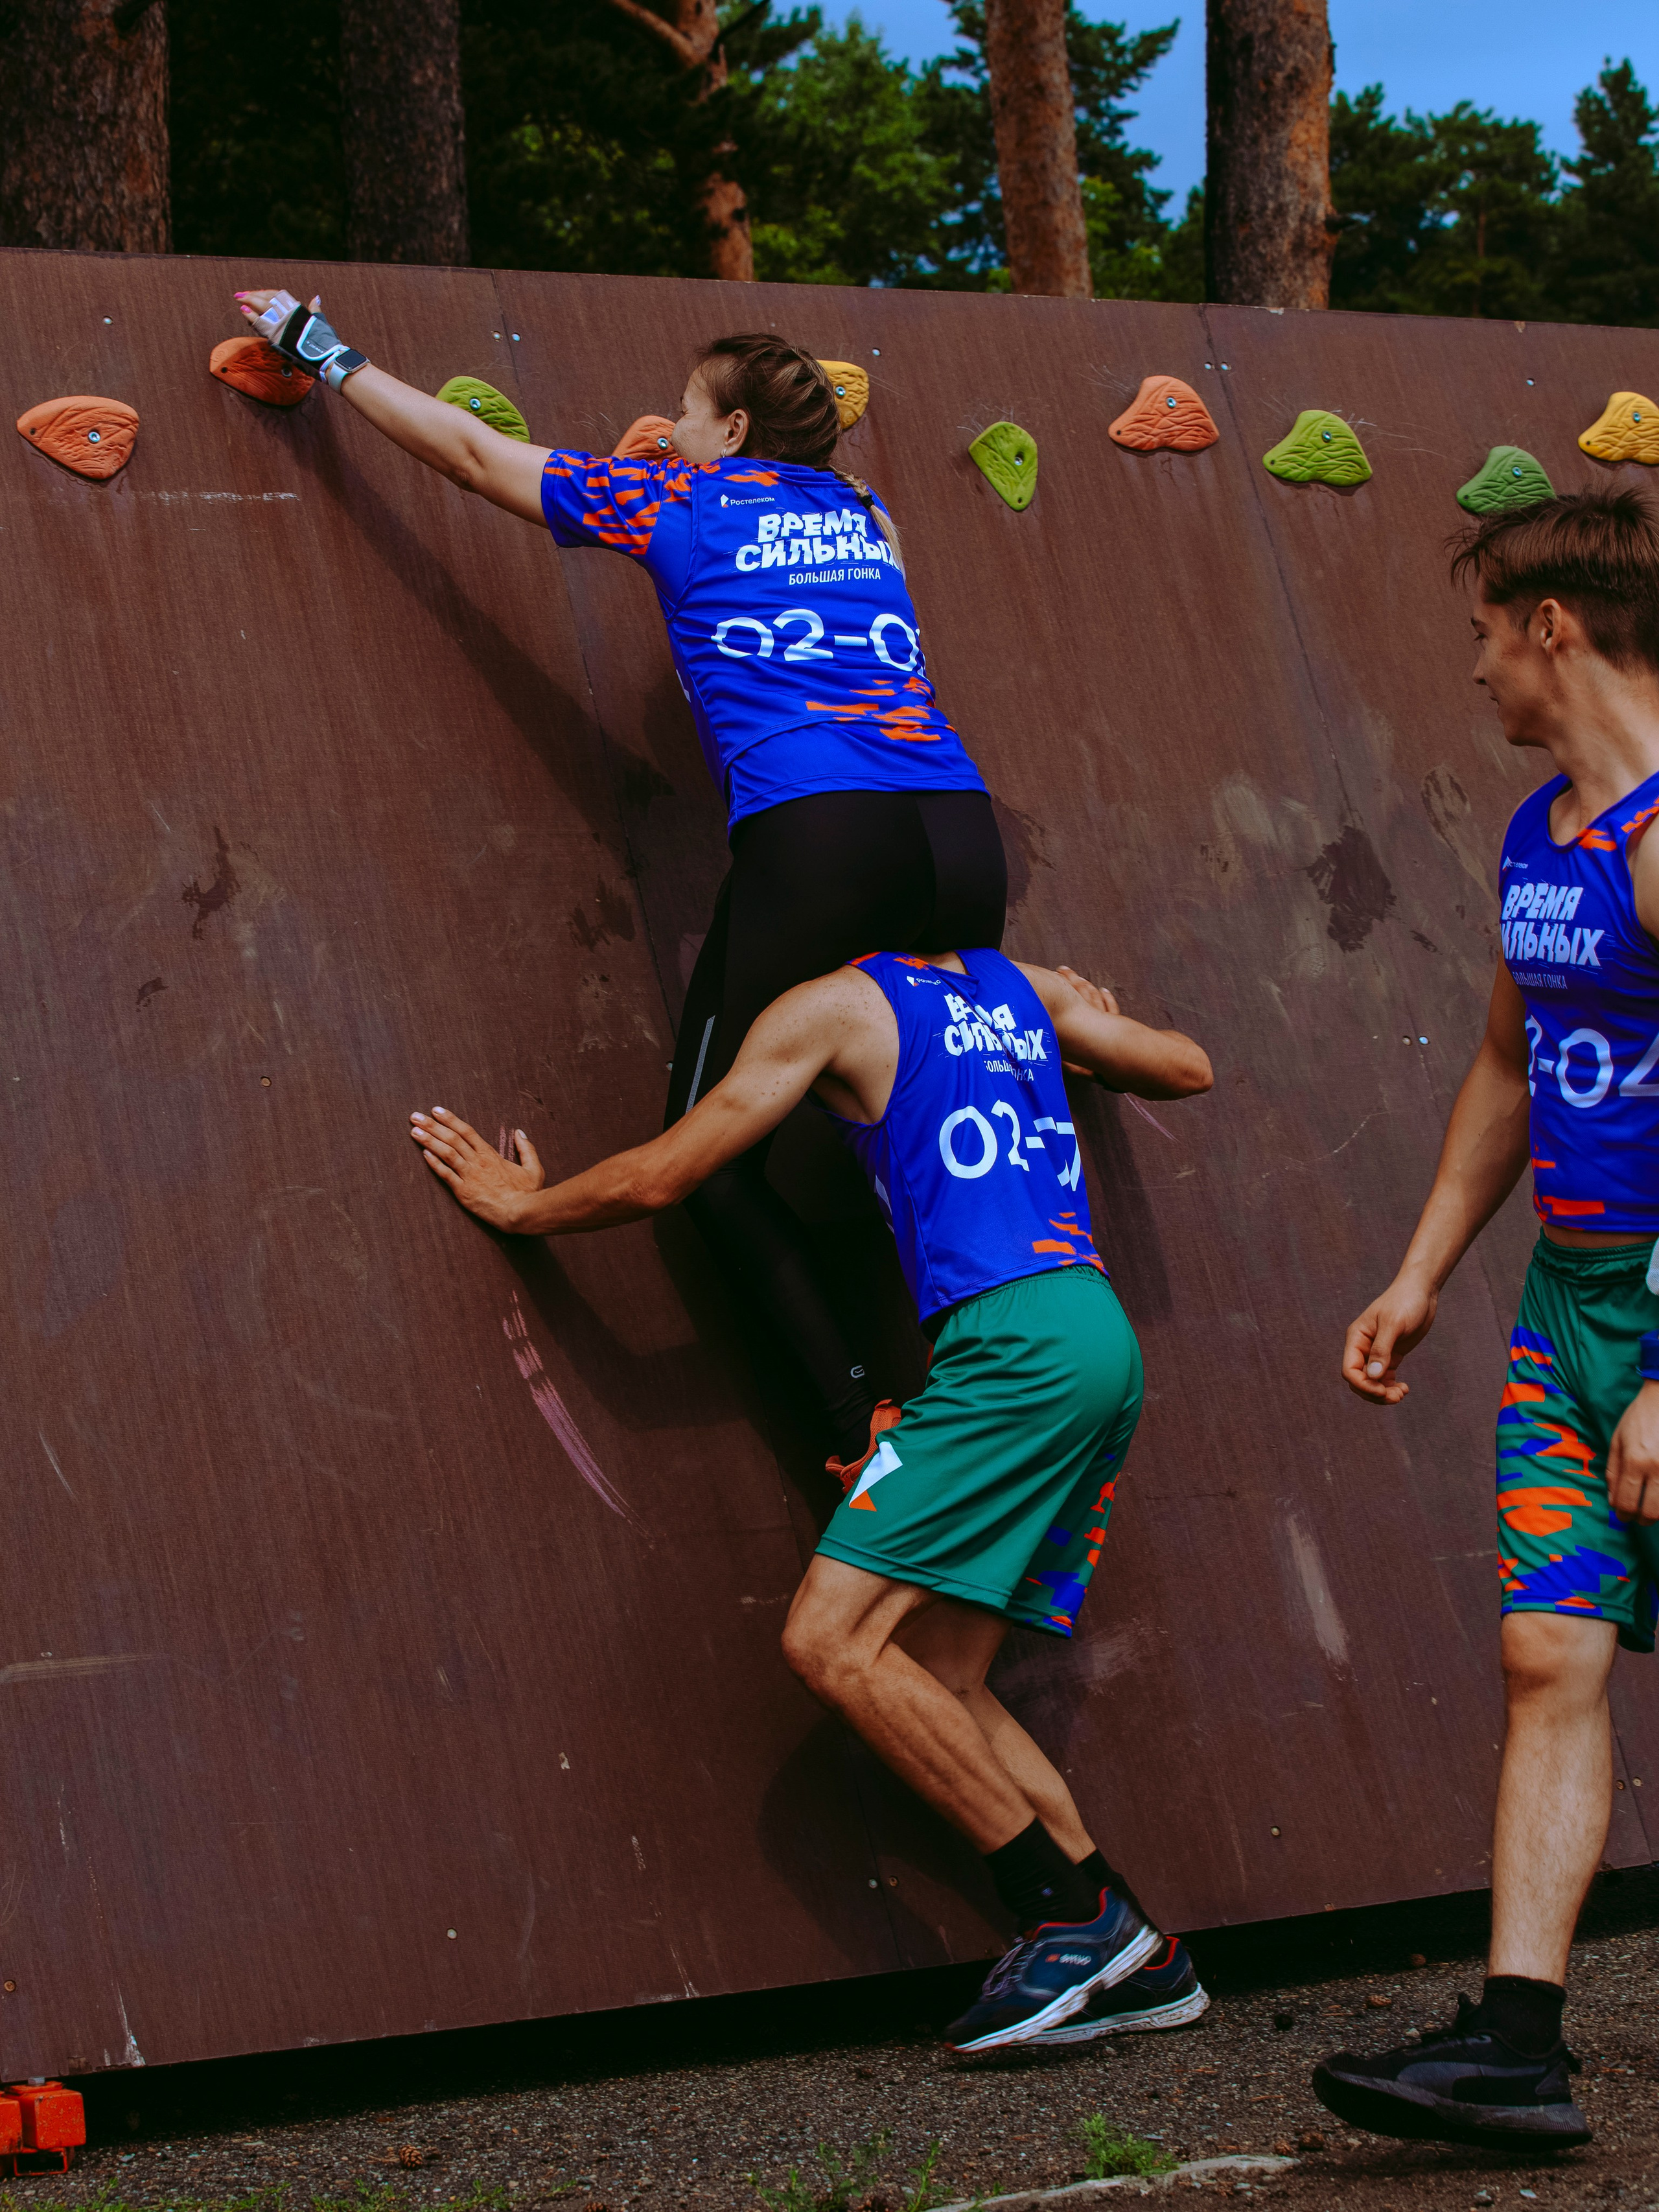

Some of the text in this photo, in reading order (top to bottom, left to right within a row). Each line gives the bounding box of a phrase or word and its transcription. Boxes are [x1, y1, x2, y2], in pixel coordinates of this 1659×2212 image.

[730, 497, 775, 506] Ростелеком
[758, 509, 868, 542] ВРЕМЯ
[789, 568, 881, 585] БОЛЬШАЯ ГОНКА
[711, 609, 929, 677] 02-0
[1502, 883, 1584, 920] ВРЕМЯ
[1501, 921, 1605, 966] ИЛЬНЫХ
[1543, 973, 1568, 989] ГОНКА
